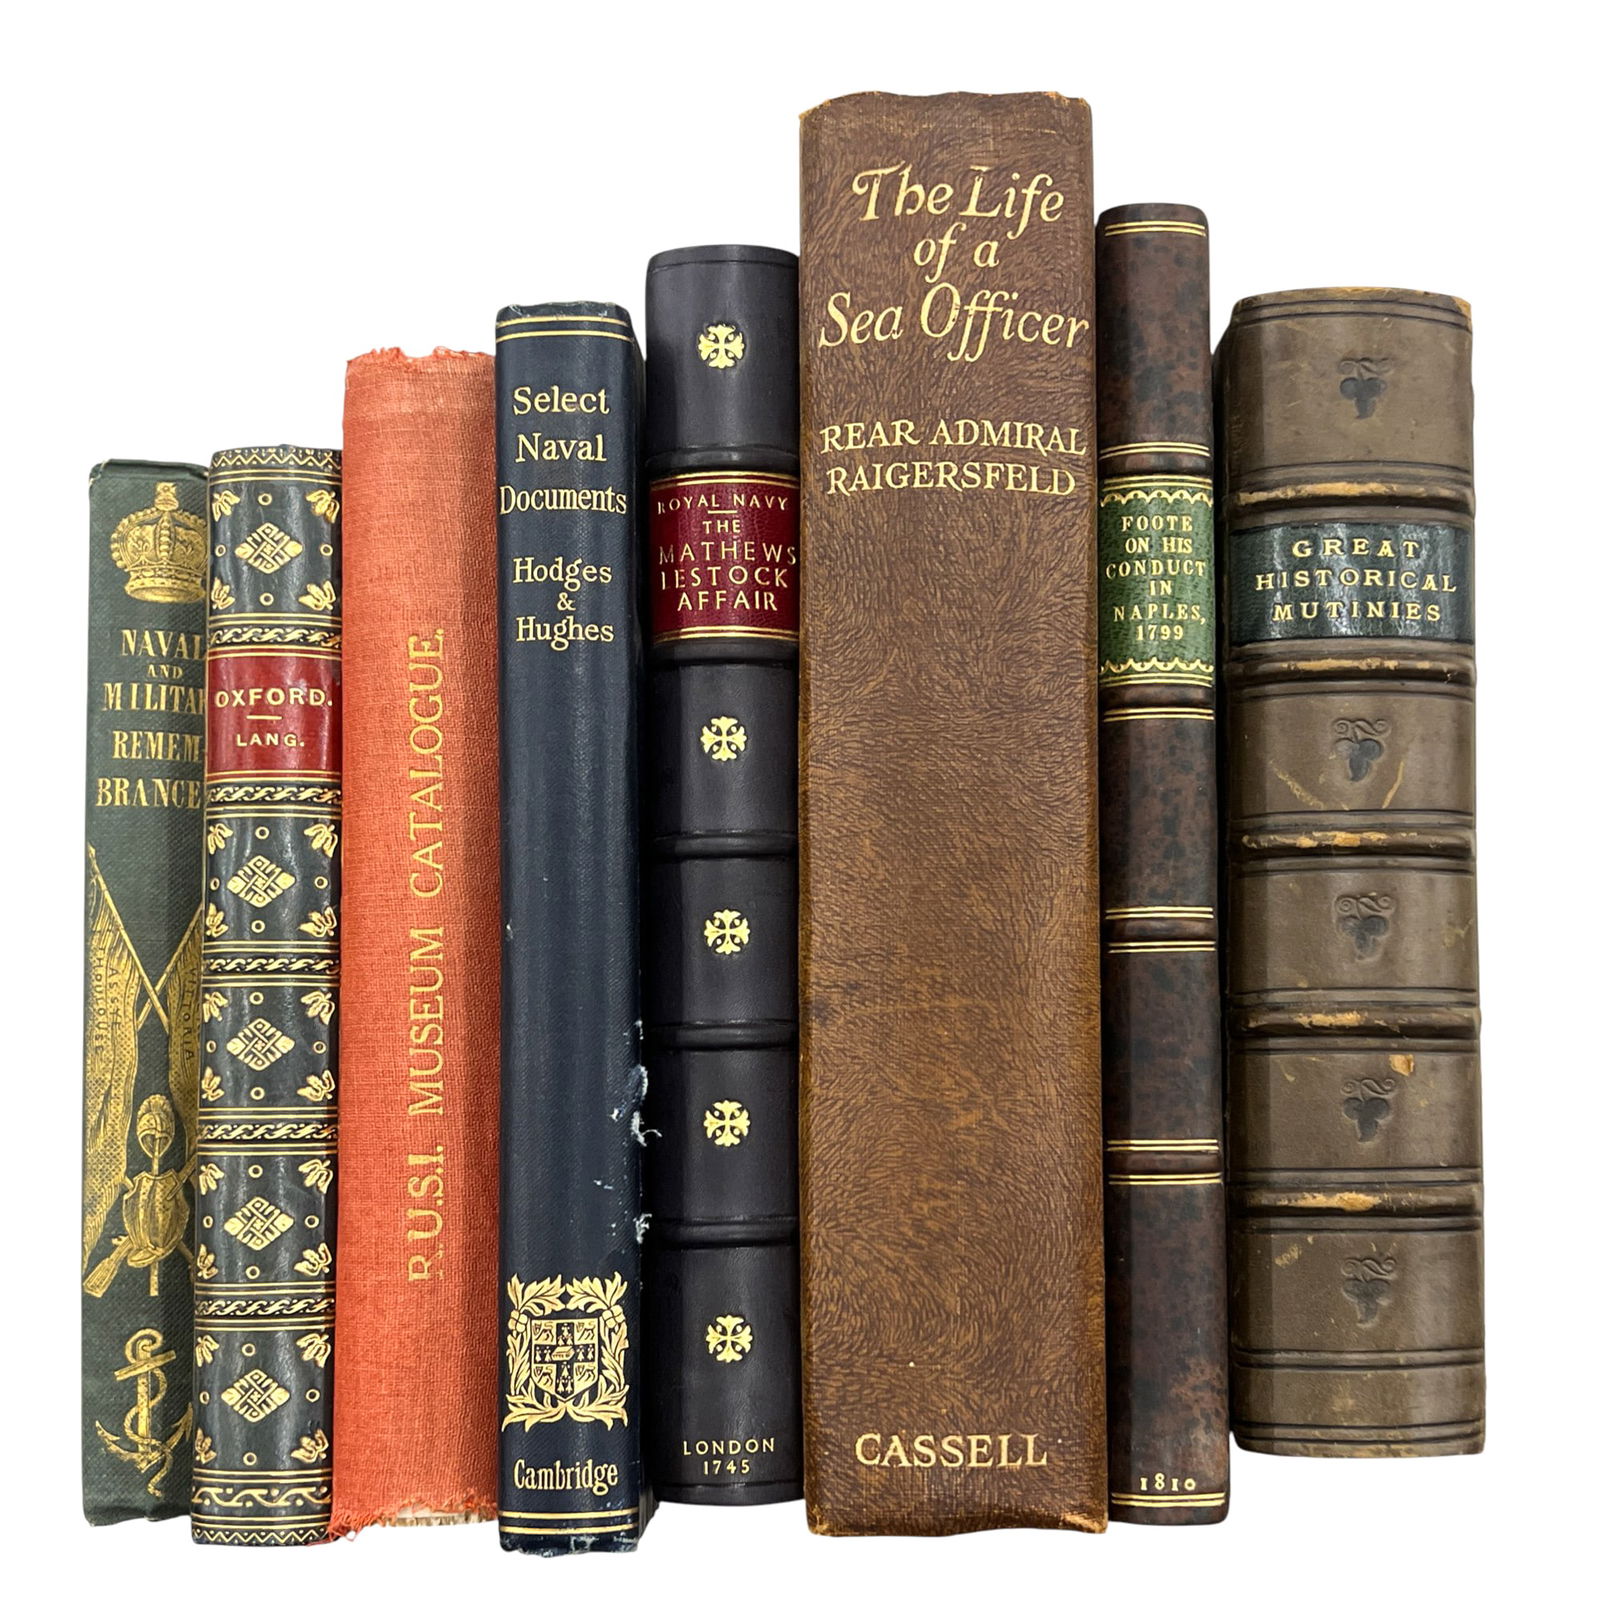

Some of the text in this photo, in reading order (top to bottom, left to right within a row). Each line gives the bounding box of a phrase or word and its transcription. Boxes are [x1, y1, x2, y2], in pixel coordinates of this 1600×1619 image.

[851, 160, 1064, 240] The Life
[913, 222, 1000, 284] of a
[818, 282, 1090, 363] Sea Officer
[512, 385, 610, 416] Select
[514, 432, 608, 463] Naval
[819, 418, 1087, 456] REAR ADMIRAL
[826, 461, 1076, 497] RAIGERSFELD
[500, 486, 627, 514] Documents
[657, 493, 788, 514] ROYAL NAVY
[702, 519, 741, 534] THE
[1121, 515, 1194, 533] FOOTE
[658, 540, 797, 566] MATHEWS
[1124, 536, 1194, 555] ON HIS
[1291, 538, 1422, 559] GREAT
[512, 556, 613, 592] Hodges
[1104, 559, 1206, 580] CONDUCT
[1149, 579, 1173, 597] IN
[1255, 569, 1457, 593] HISTORICAL
[556, 592, 577, 611] &
[677, 590, 777, 611] AFFAIR
[1113, 604, 1207, 625] NAPLES,
[1271, 602, 1442, 622] MUTINIES
[516, 615, 615, 651] Hughes
[1135, 625, 1185, 641] 1799
[148, 664, 183, 679] AND
[215, 688, 333, 709] OXFORD.
[236, 733, 305, 748] LANG.
[406, 628, 446, 1282] R.U.S.I. MUSEUM CATALOGUE.
[182, 967, 198, 1061] VITTORIA
[683, 1437, 775, 1456] LONDON
[855, 1432, 1048, 1468] CASSELL
[513, 1458, 619, 1496] Cambridge
[703, 1459, 751, 1475] 1745
[1140, 1473, 1196, 1491] 1810
